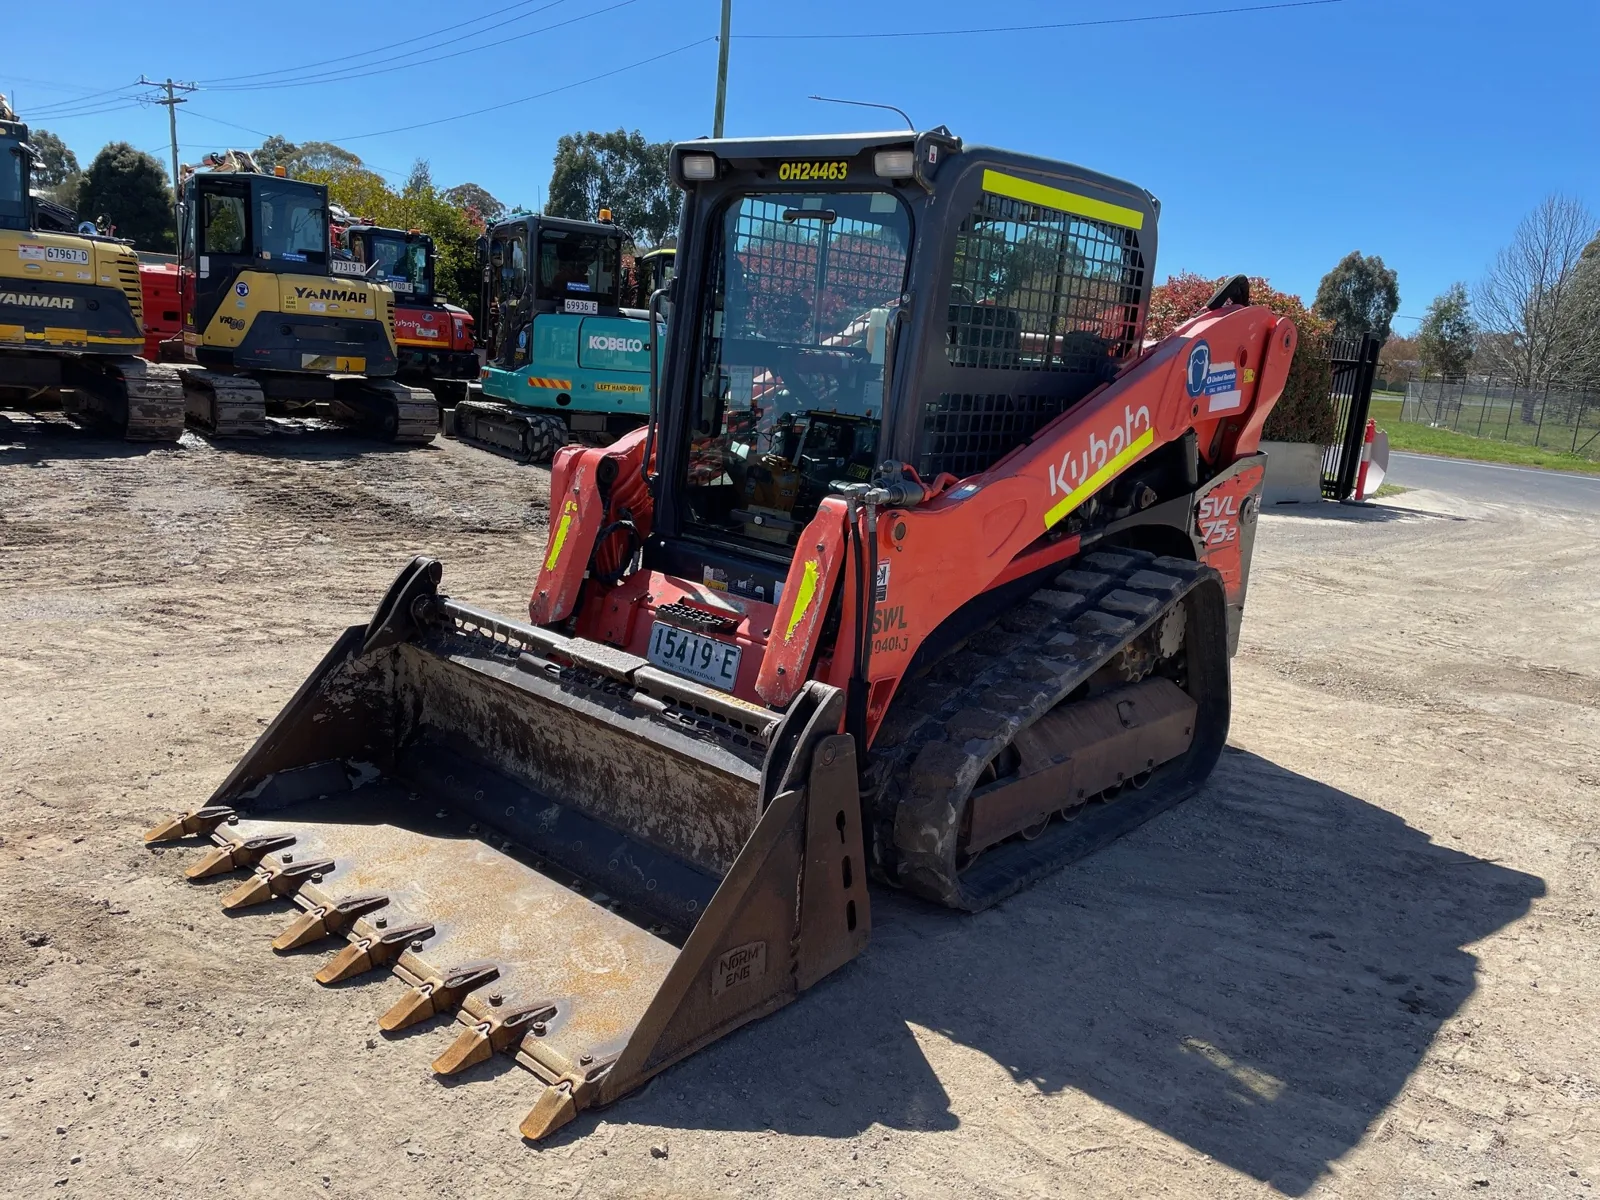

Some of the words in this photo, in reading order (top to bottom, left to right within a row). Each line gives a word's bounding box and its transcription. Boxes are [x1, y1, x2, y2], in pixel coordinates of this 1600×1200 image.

[779, 162, 848, 180] OH24463
[47, 248, 77, 260] 67967
[294, 287, 367, 304] YANMAR
[566, 301, 588, 311] 69936
[592, 303, 597, 311] E
[589, 335, 643, 352] KOBELCO
[1199, 496, 1237, 519] SVL
[872, 605, 908, 635] SWL
[655, 628, 713, 670] 15419
[720, 649, 737, 679] E
[678, 666, 717, 682] CONDITIONAL
[720, 947, 759, 975] NORM
